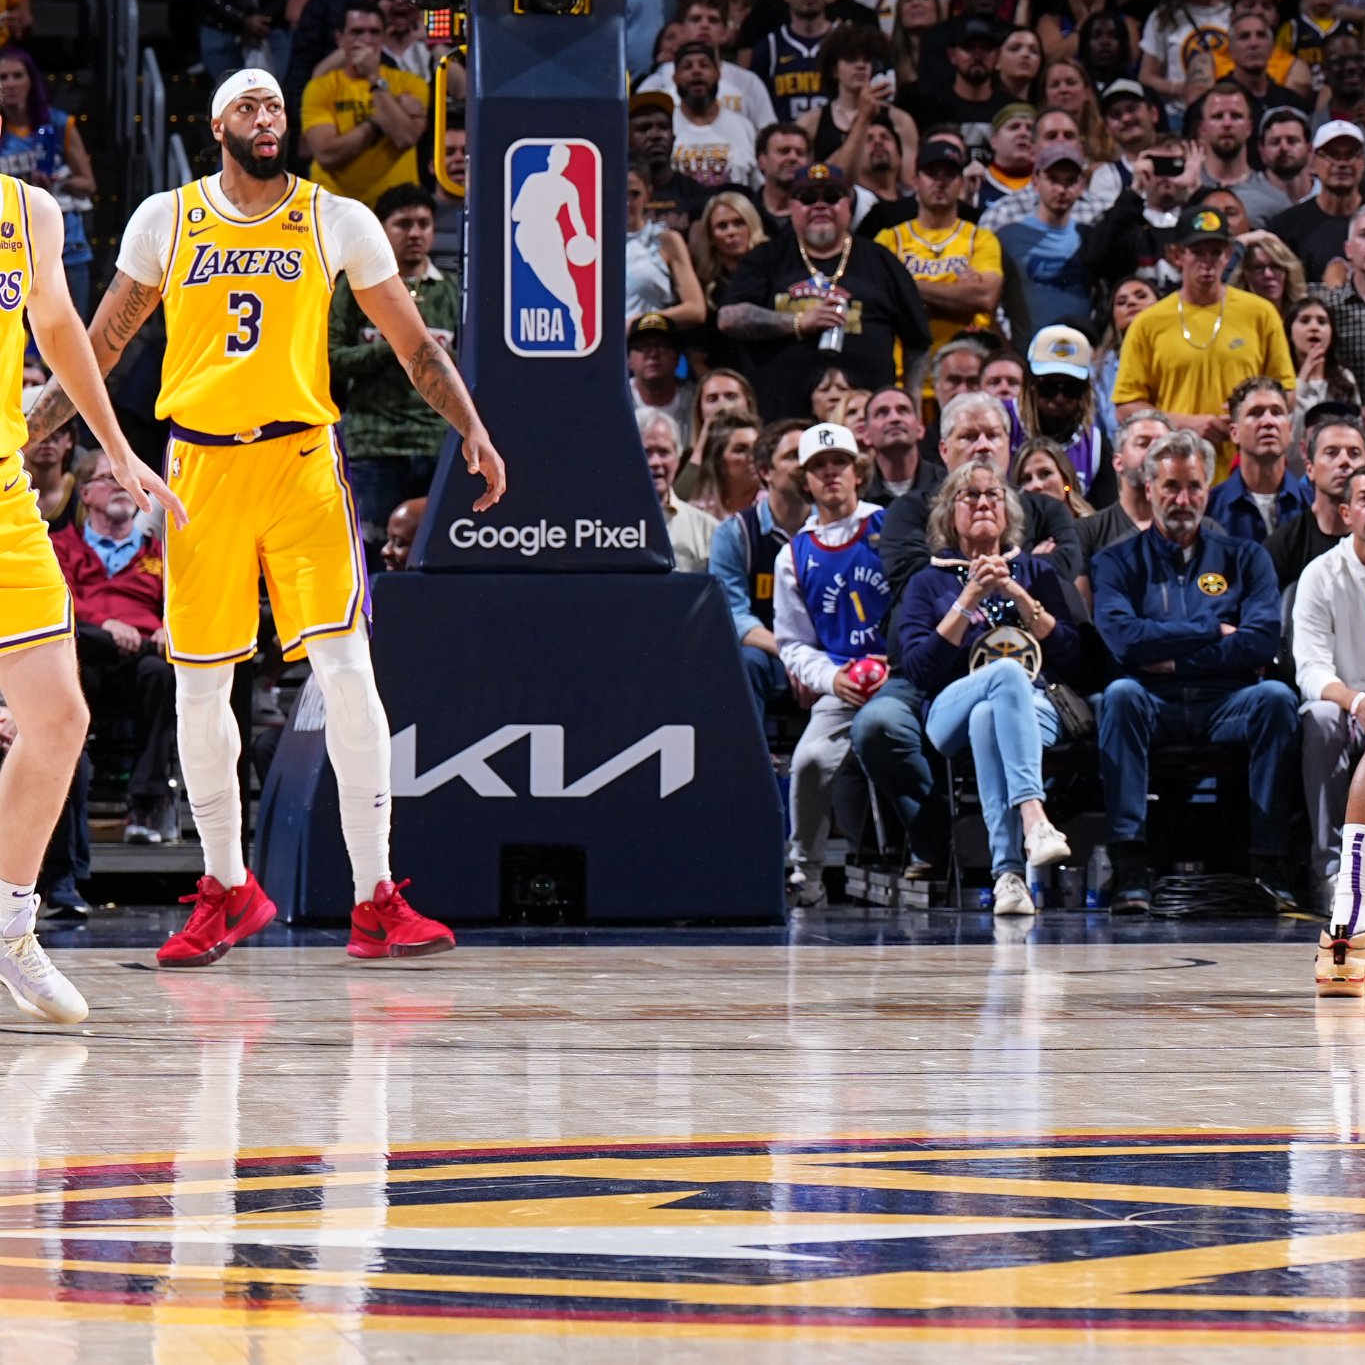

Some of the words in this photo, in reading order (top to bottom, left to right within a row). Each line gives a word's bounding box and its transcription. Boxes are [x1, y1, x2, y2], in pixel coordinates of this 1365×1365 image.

[773, 71, 822, 97] DENV
[281, 221, 310, 235] bibigo
[0, 239, 23, 253] ibigo
[182, 242, 304, 288] LAKERS
[900, 254, 972, 277] LAKERS
[224, 291, 264, 358] 3
[518, 307, 566, 344] NBA
[448, 516, 567, 557] Google
[574, 517, 648, 551] Pixel
[820, 572, 847, 615] MILE
[854, 565, 893, 596] HIGH
[848, 590, 866, 623] 1
